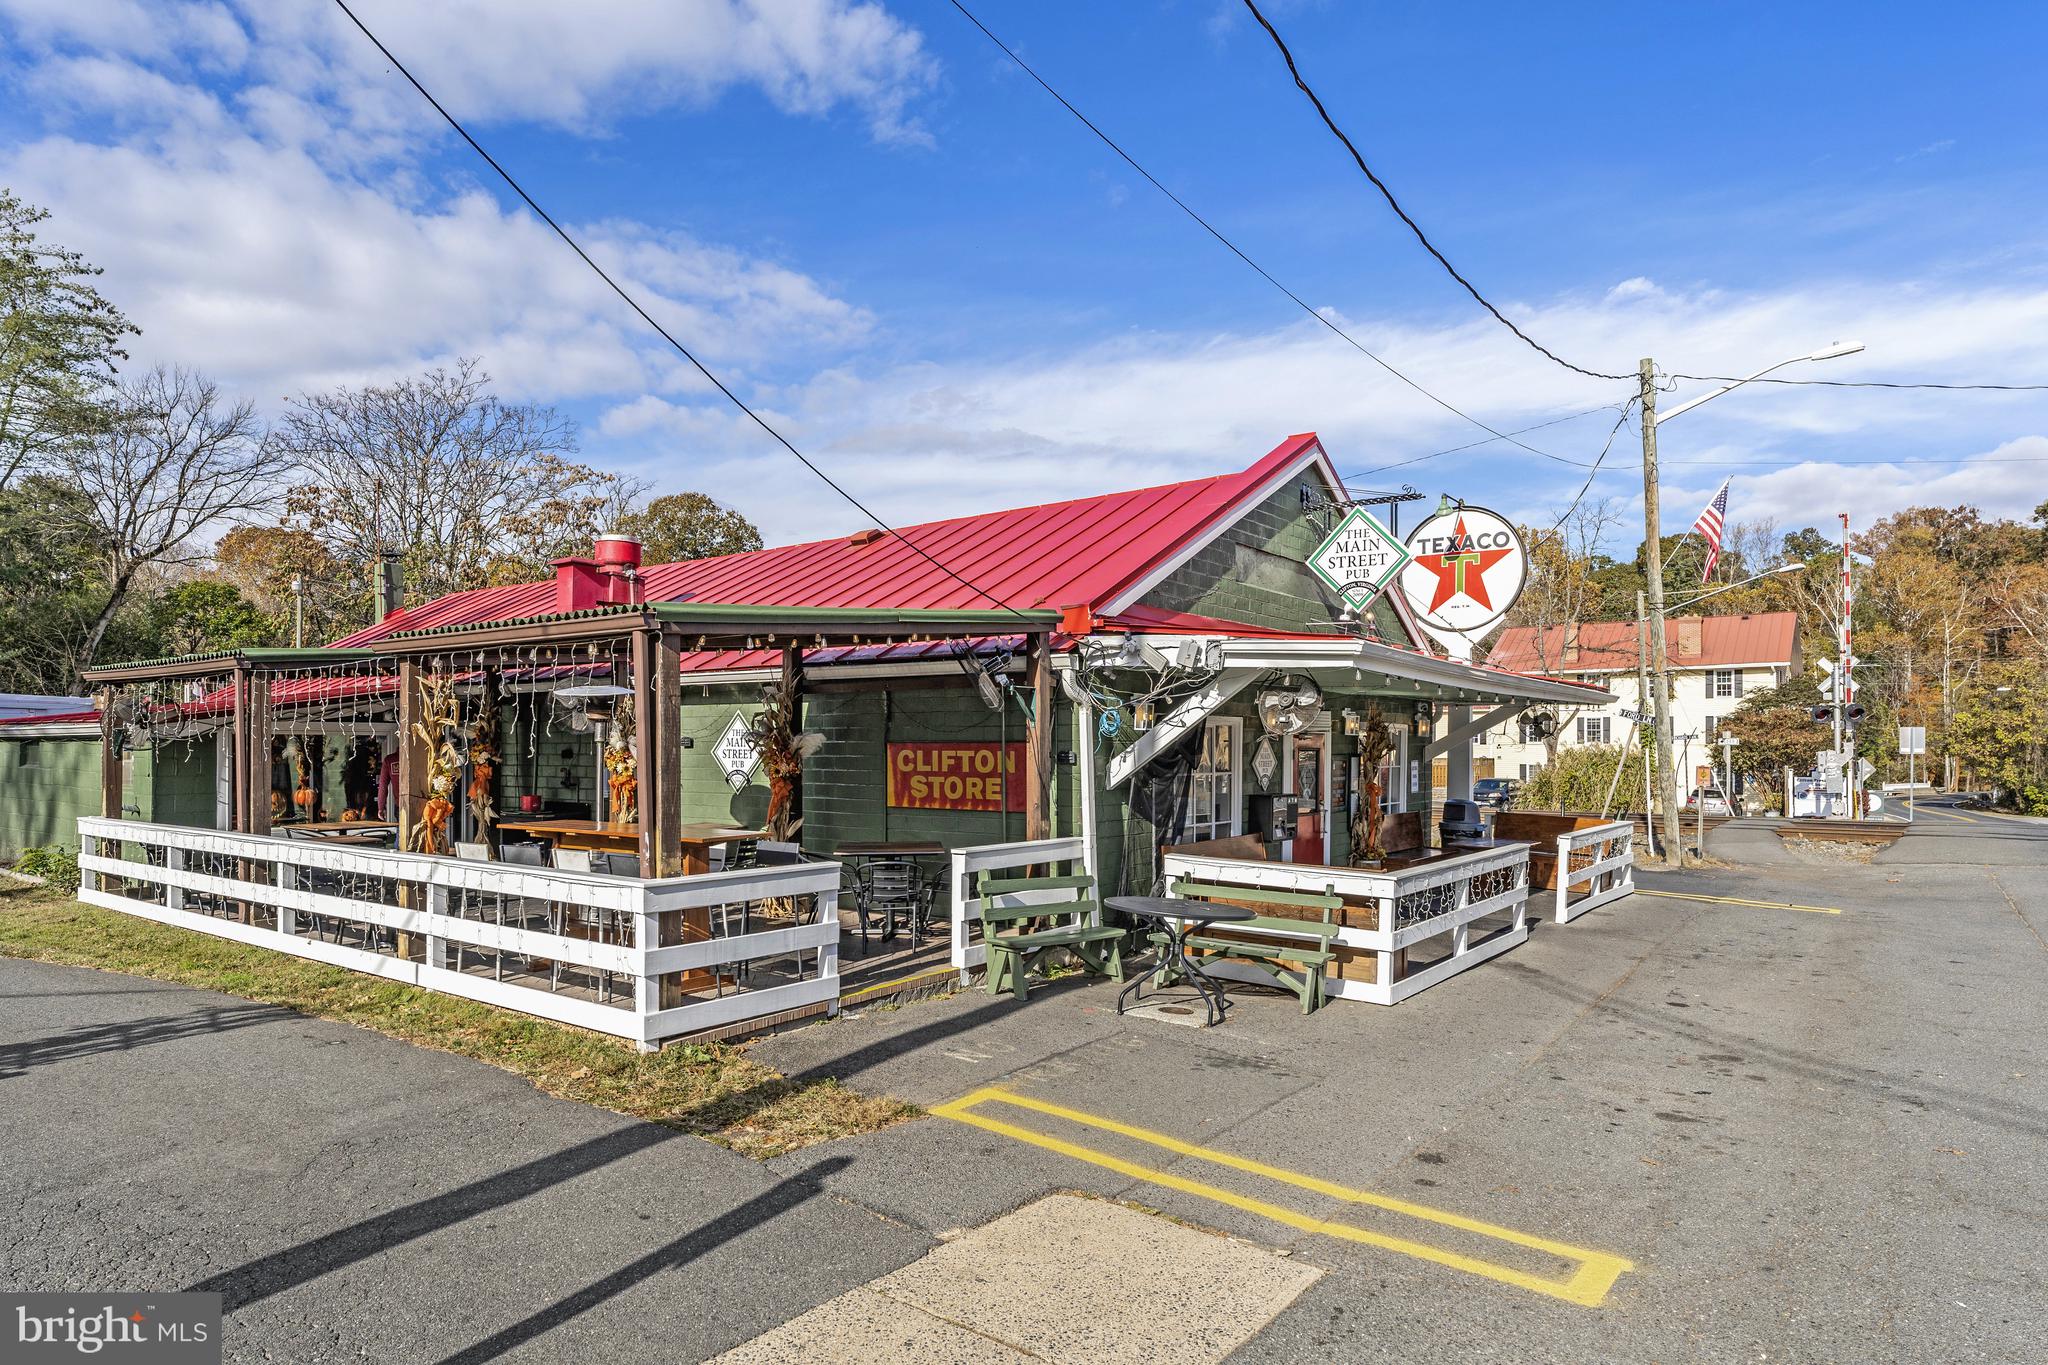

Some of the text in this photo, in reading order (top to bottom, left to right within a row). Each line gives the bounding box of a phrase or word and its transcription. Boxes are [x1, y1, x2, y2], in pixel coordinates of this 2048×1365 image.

[1345, 528, 1371, 540] THE
[1335, 538, 1380, 554] MAIN
[1417, 531, 1511, 555] TEXACO
[1328, 553, 1388, 570] STREET
[1346, 568, 1370, 579] PUB
[732, 729, 745, 737] THE
[722, 748, 754, 759] STREET
[731, 760, 745, 768] PUB
[897, 749, 1016, 774] CLIFTON
[910, 775, 1003, 801] STORE
